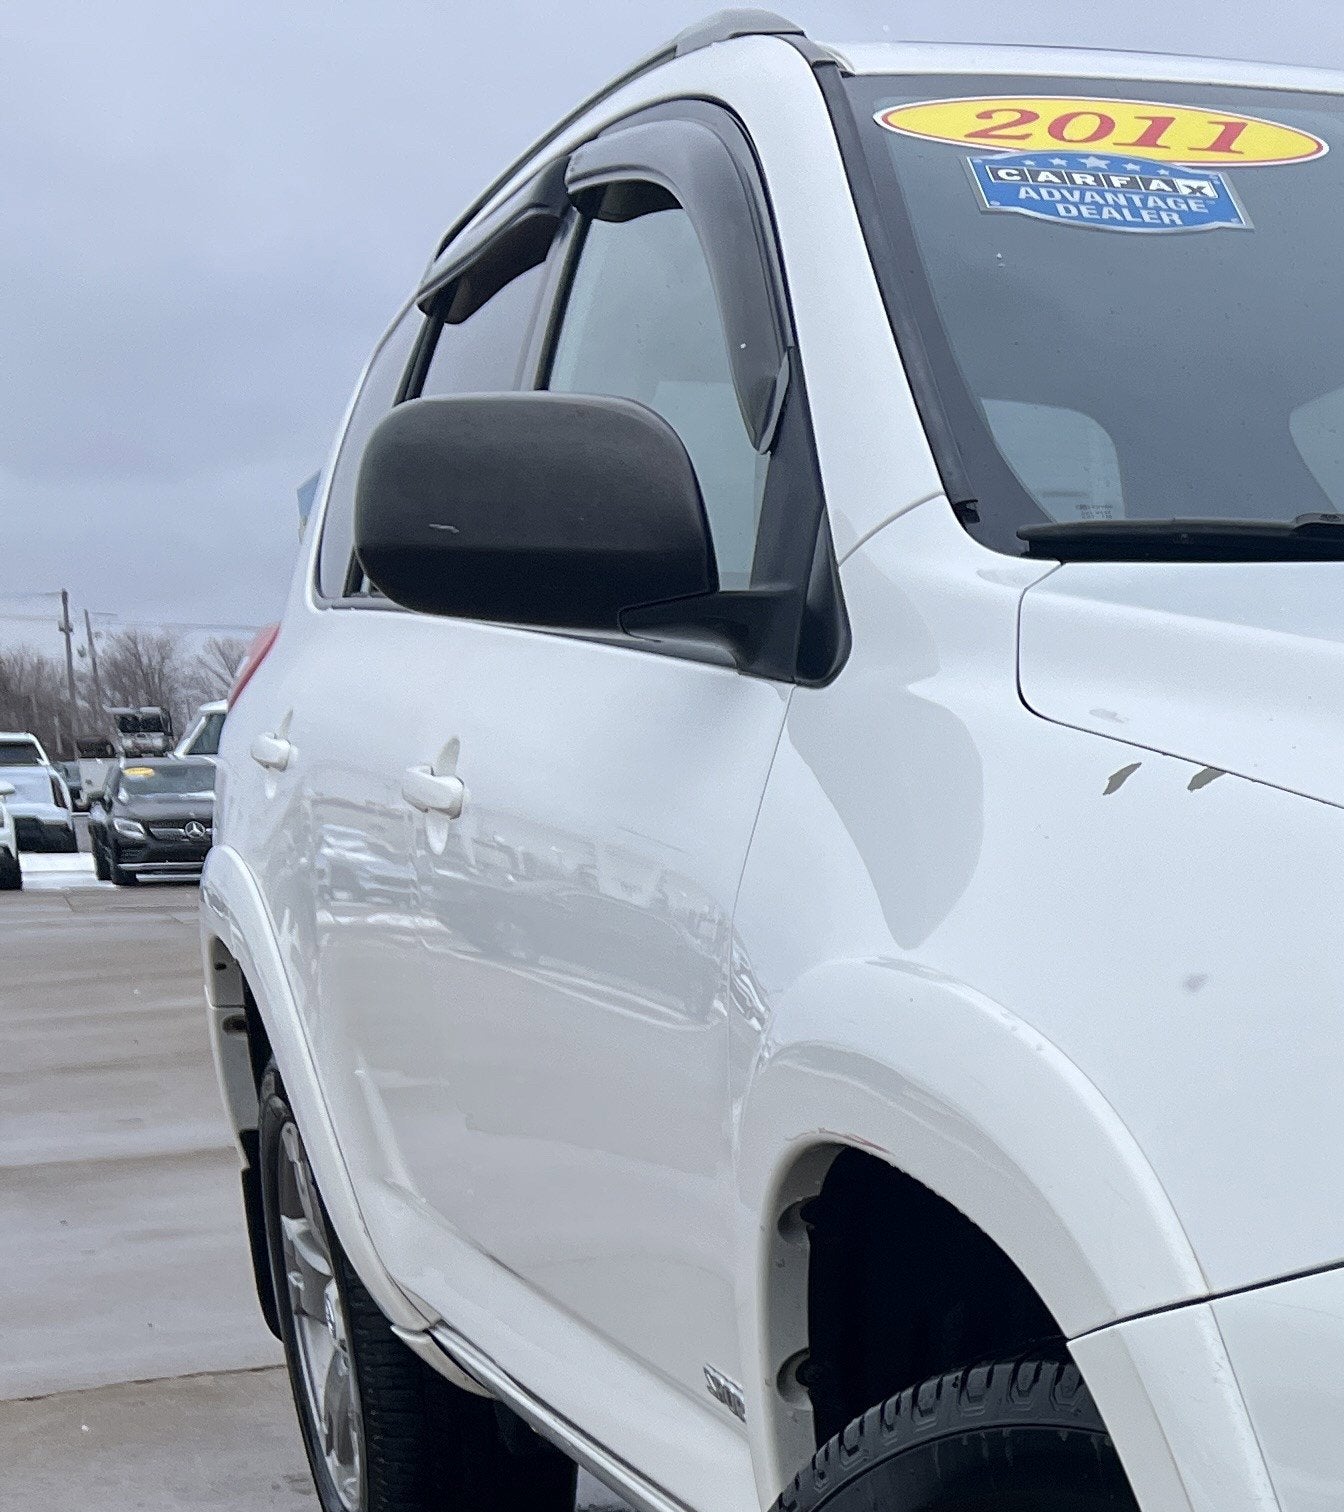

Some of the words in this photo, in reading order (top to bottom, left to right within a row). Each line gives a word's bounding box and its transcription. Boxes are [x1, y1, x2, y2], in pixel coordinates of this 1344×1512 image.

[964, 108, 1248, 155] 2011
[996, 167, 1218, 198] CARFAX
[1018, 185, 1209, 214] ADVANTAGE
[1055, 203, 1182, 226] DEALER
